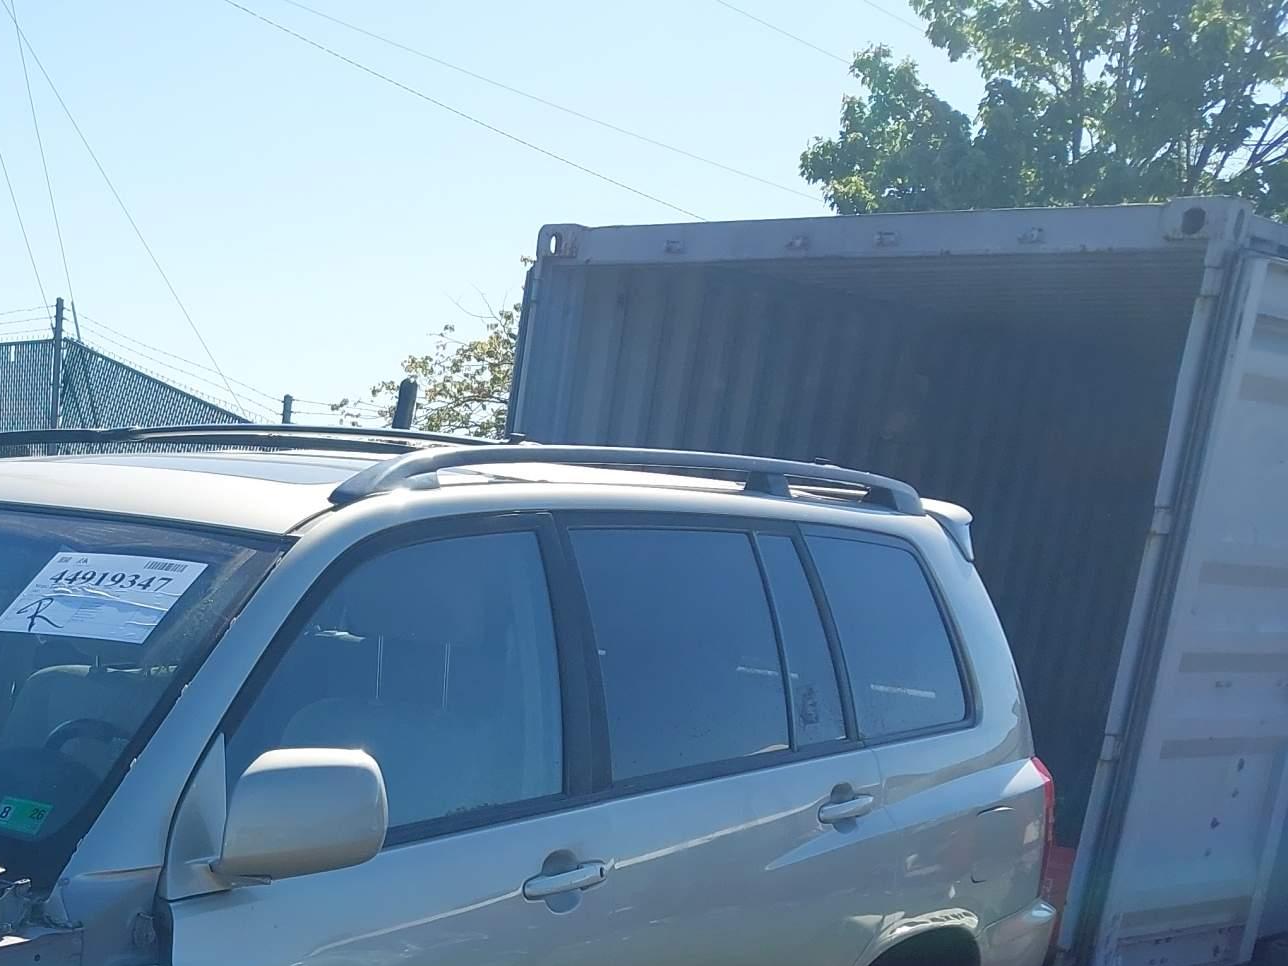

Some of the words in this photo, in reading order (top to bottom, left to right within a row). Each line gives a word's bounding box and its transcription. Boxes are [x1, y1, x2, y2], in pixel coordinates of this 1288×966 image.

[49, 569, 173, 591] 44919347
[0, 806, 11, 818] 8
[29, 808, 47, 820] 26
